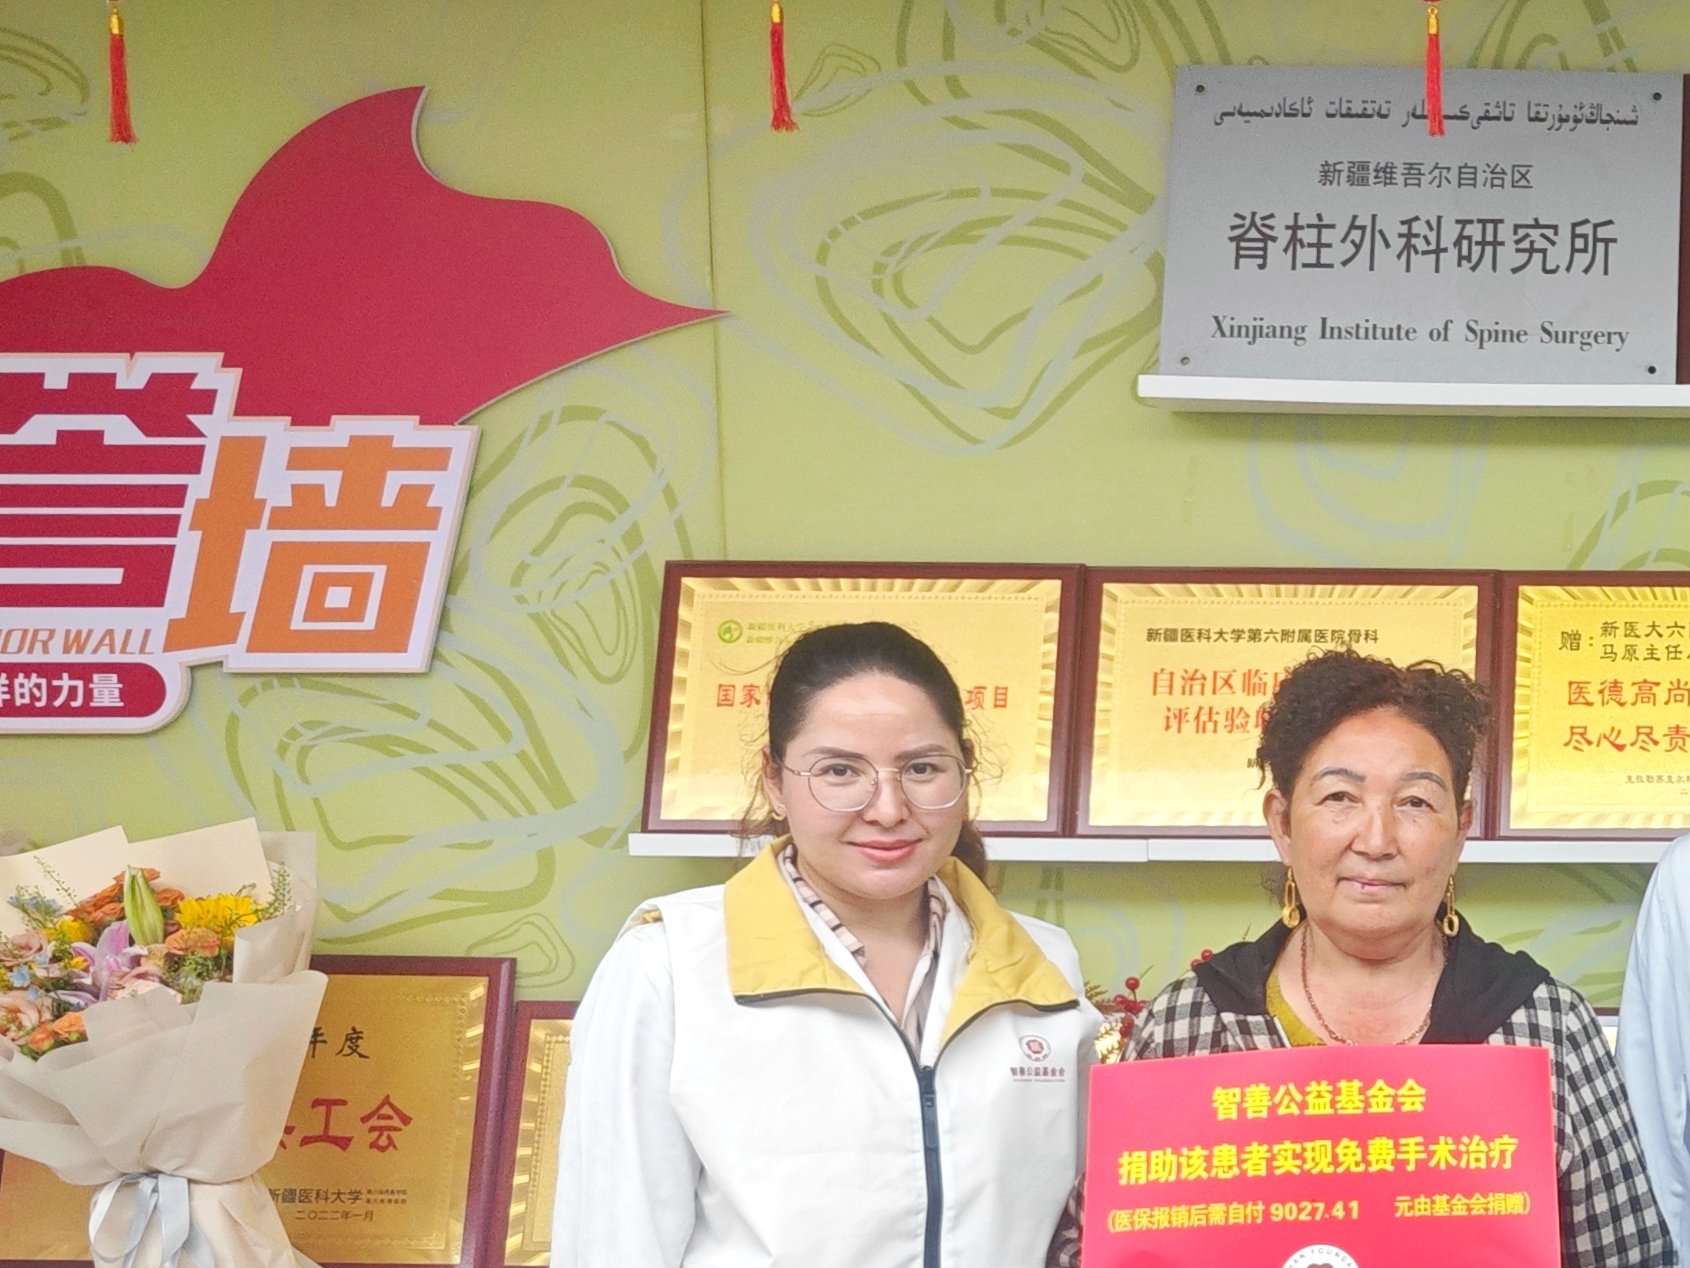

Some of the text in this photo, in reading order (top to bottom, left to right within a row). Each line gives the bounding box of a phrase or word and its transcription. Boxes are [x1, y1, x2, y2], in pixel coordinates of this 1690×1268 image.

[1318, 160, 1535, 189] 新疆维吾尔自治区
[1228, 210, 1619, 277] 脊柱外科研究所
[1211, 315, 1630, 353] Xinjiang Institute of Spine Surgery
[0, 628, 155, 655] OR WALL
[1146, 627, 1379, 644] 新疆医科大学第六附属医院骨科
[1163, 706, 1269, 735] 评估验
[1212, 1079, 1426, 1121] 智善公益基金会
[279, 1094, 413, 1153] 工会
[1118, 1135, 1519, 1186] 捐助该患者实现免费手术治疗
[268, 1188, 363, 1205] 新疆医科大学
[1270, 1201, 1359, 1222] 9027.41
